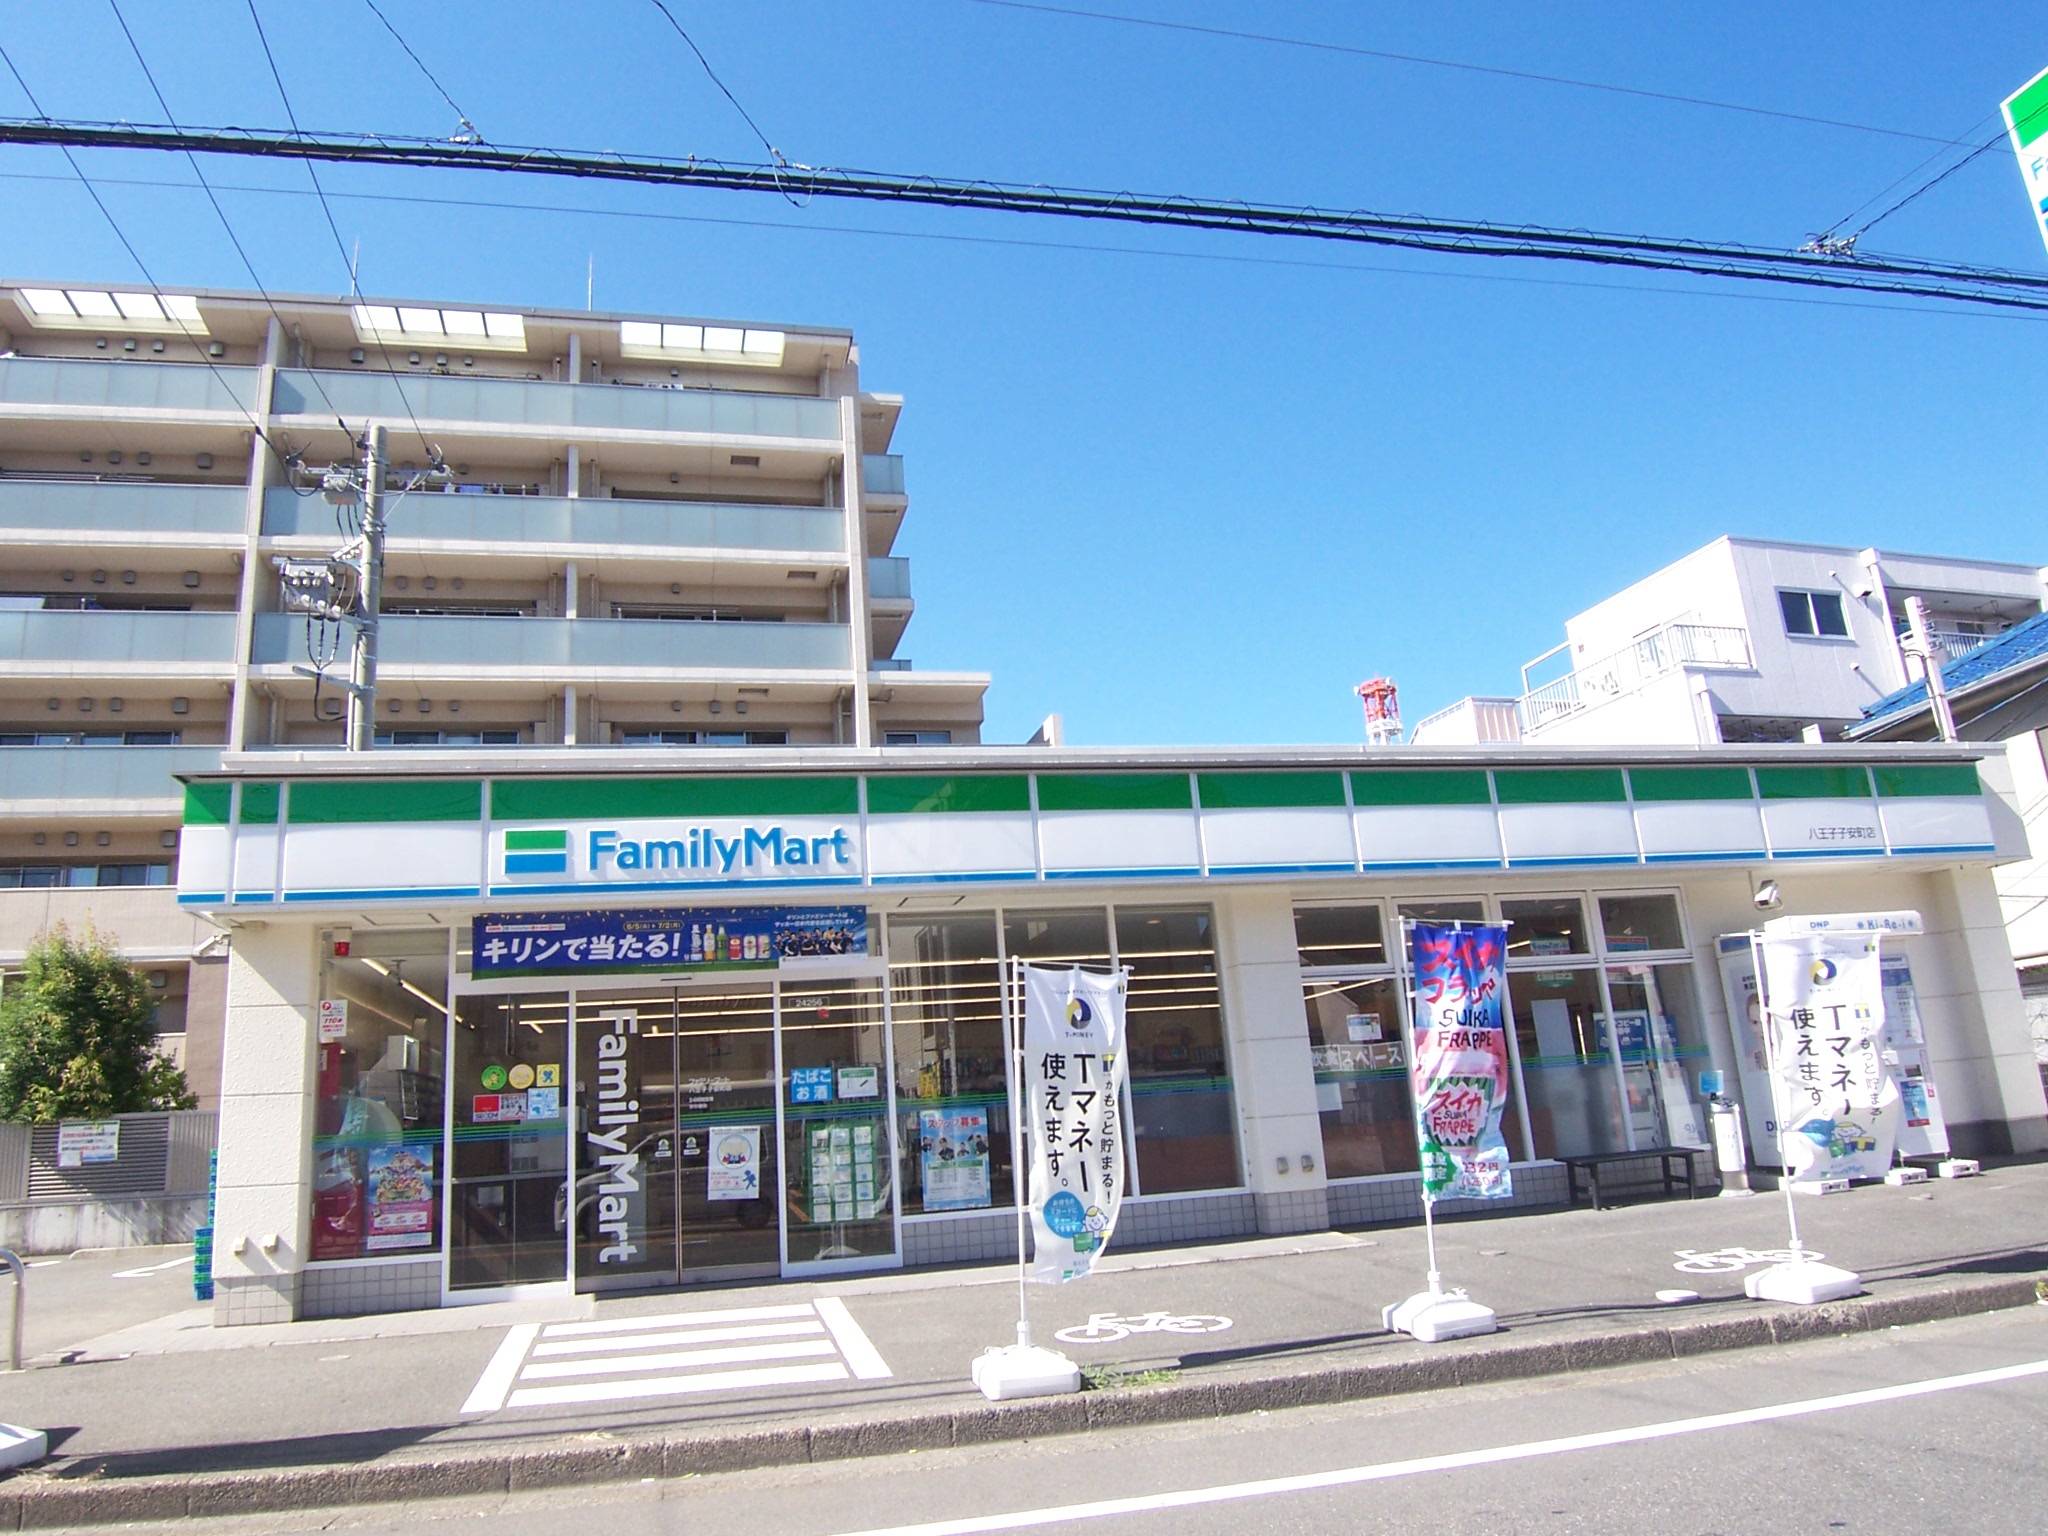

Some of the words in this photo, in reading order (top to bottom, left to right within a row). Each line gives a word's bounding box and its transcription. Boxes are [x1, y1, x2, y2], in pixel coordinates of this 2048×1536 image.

[1809, 827, 1876, 839] 八王子子安町店
[587, 826, 850, 874] FamilyMart
[1810, 920, 1829, 929] DNP
[1421, 938, 1499, 973] スイカ
[1438, 1008, 1490, 1028] SUIKA
[1437, 1030, 1493, 1049] FRAPPE
[792, 1069, 832, 1085] たばこ
[796, 1084, 828, 1100] お酒
[1431, 1090, 1481, 1116] スイカ
[928, 1116, 980, 1128] スタッフ募集
[1041, 1052, 1068, 1188] 使えます。
[1069, 1053, 1097, 1193] Tマネー
[1433, 1117, 1475, 1136] FRAPPE
[587, 1008, 639, 1264] FamilyMart
